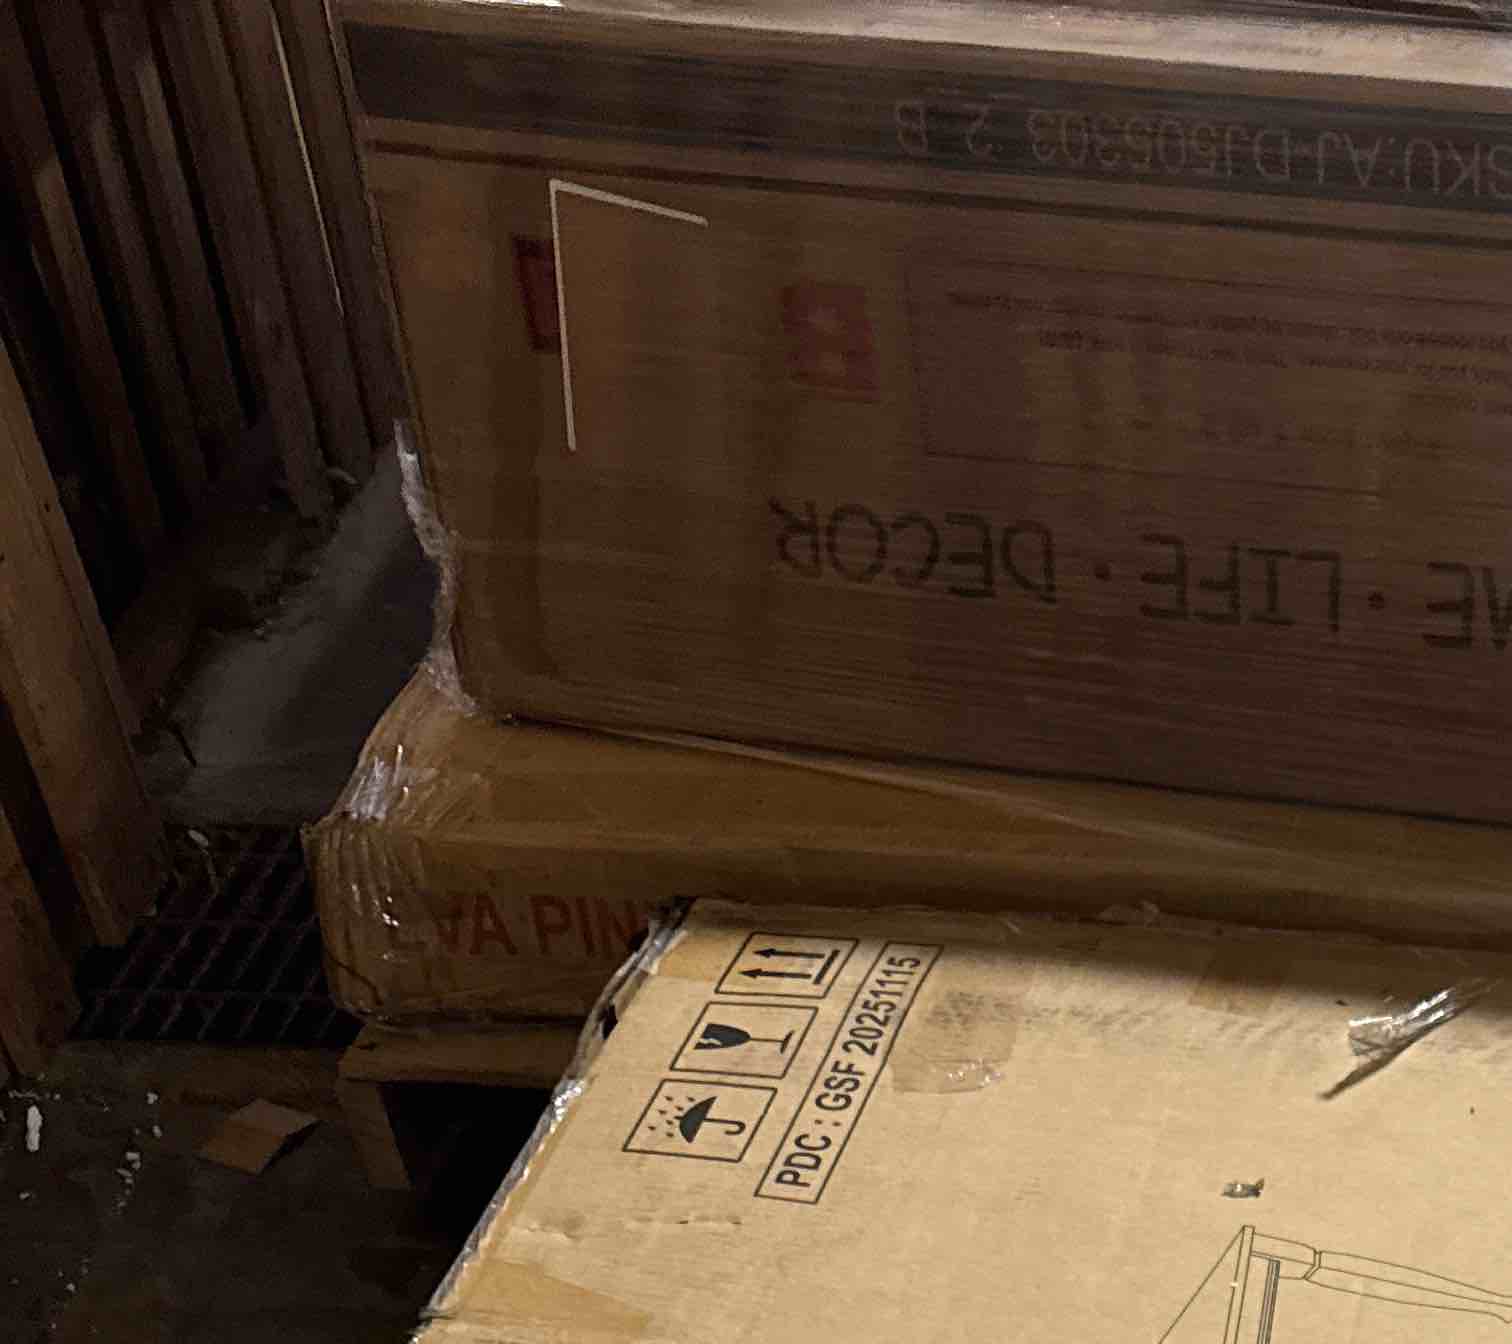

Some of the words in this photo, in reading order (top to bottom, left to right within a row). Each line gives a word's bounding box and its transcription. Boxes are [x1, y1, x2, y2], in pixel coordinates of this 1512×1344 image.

[769, 496, 1057, 605] DECOR
[1140, 533, 1342, 636] LIFE
[773, 1133, 833, 1188] PDC
[814, 1059, 866, 1112] GSF
[841, 956, 921, 1057] 20251115
